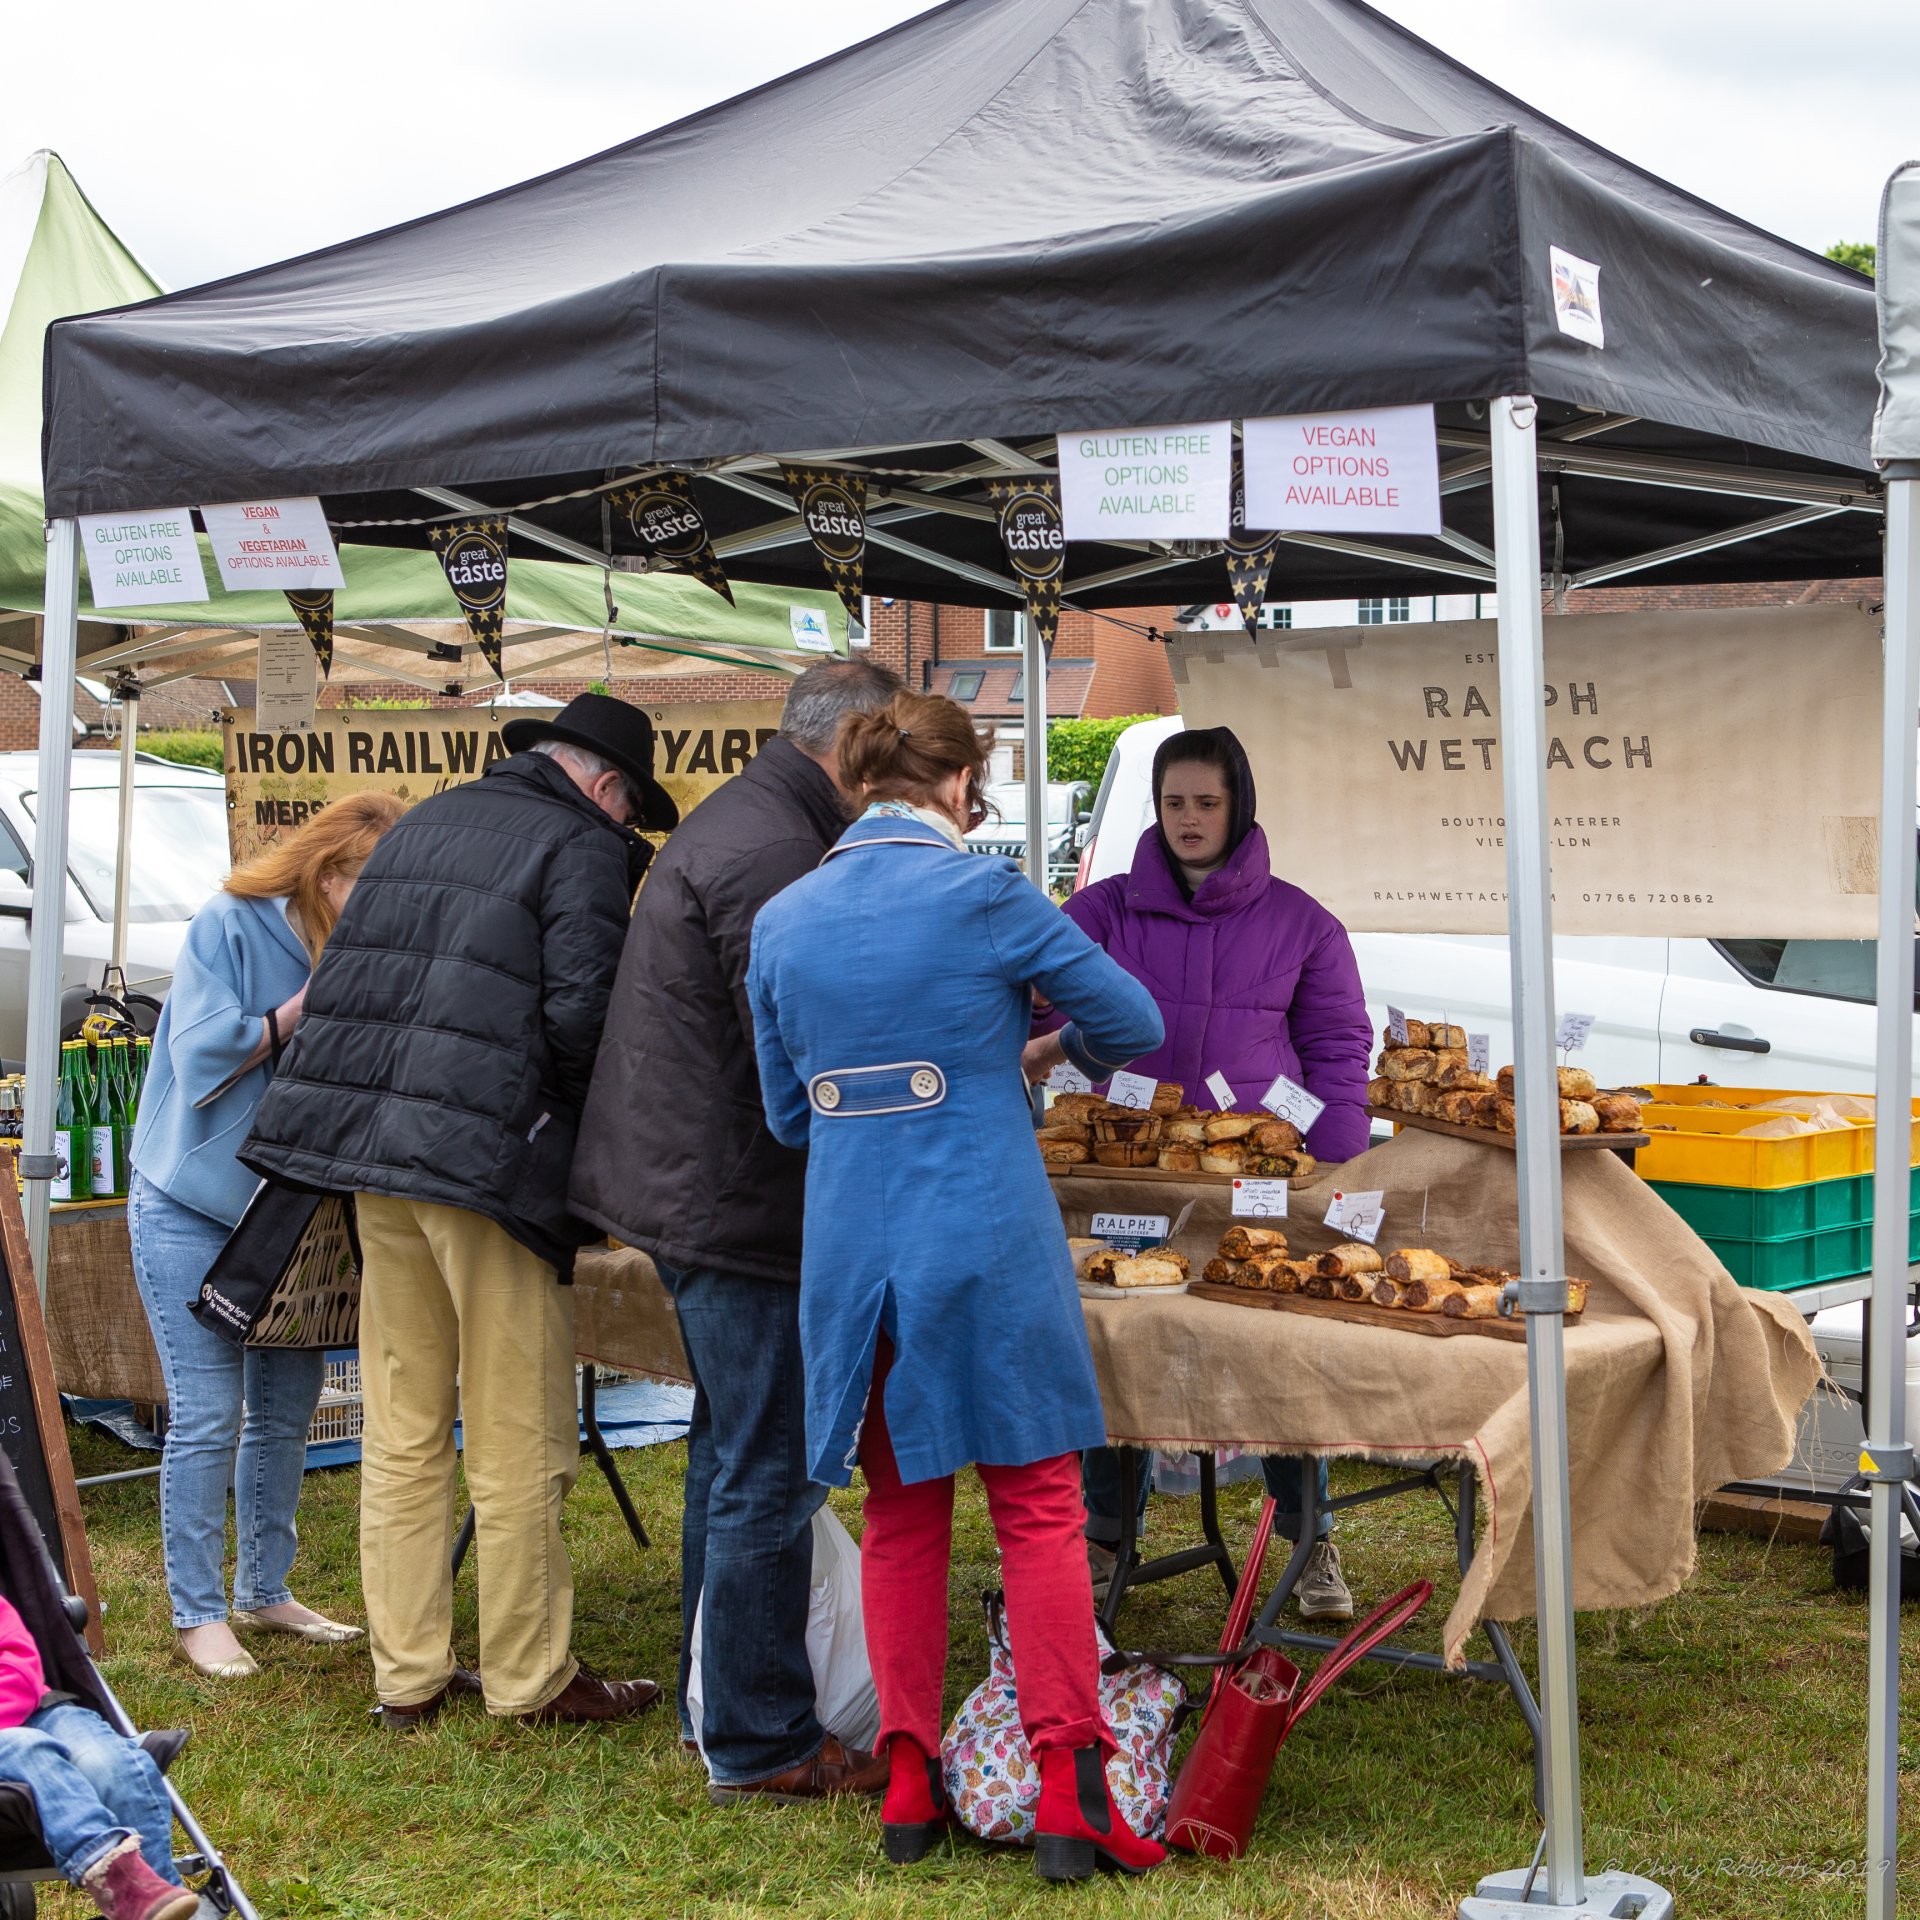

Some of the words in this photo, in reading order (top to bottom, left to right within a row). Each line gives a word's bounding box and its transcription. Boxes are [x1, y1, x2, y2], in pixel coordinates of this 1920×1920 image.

[1080, 438, 1158, 459] GLUTEN
[1164, 435, 1211, 455] FREE
[1302, 426, 1376, 447] VEGAN
[1104, 465, 1189, 486] OPTIONS
[1293, 456, 1390, 477] OPTIONS
[817, 499, 846, 514] great
[1098, 494, 1196, 515] AVAILABLE
[1285, 486, 1399, 508] AVAILABLE
[241, 506, 280, 519] VEGAN
[644, 504, 676, 525] great
[1015, 511, 1047, 528] great
[95, 525, 148, 543] GLUTEN
[151, 522, 182, 538] FREE
[263, 524, 271, 535] &
[639, 512, 701, 544] taste
[806, 511, 862, 538] taste
[239, 538, 308, 552] VEGETARIAN
[1005, 526, 1063, 550] taste
[115, 545, 173, 565] OPTIONS
[228, 557, 274, 570] OPTIONS
[276, 554, 330, 568] AVAILABLE
[460, 547, 489, 566] great
[116, 568, 183, 587] AVAILABLE
[449, 560, 505, 585] taste
[1423, 682, 1598, 718] RAPH
[236, 732, 335, 774] IRON
[348, 731, 507, 774] RAILWA
[1388, 735, 1653, 771] WETACH
[255, 800, 328, 825] MERS
[1441, 817, 1506, 827] BOUTIQ
[1553, 817, 1621, 827] ATERER
[1583, 893, 1636, 903] 07766
[1647, 893, 1714, 904] 720862
[1096, 1217, 1156, 1231] RALPH'S
[212, 1289, 235, 1312] Treading
[233, 1306, 251, 1322] lightl
[215, 1304, 241, 1327] Waitrose
